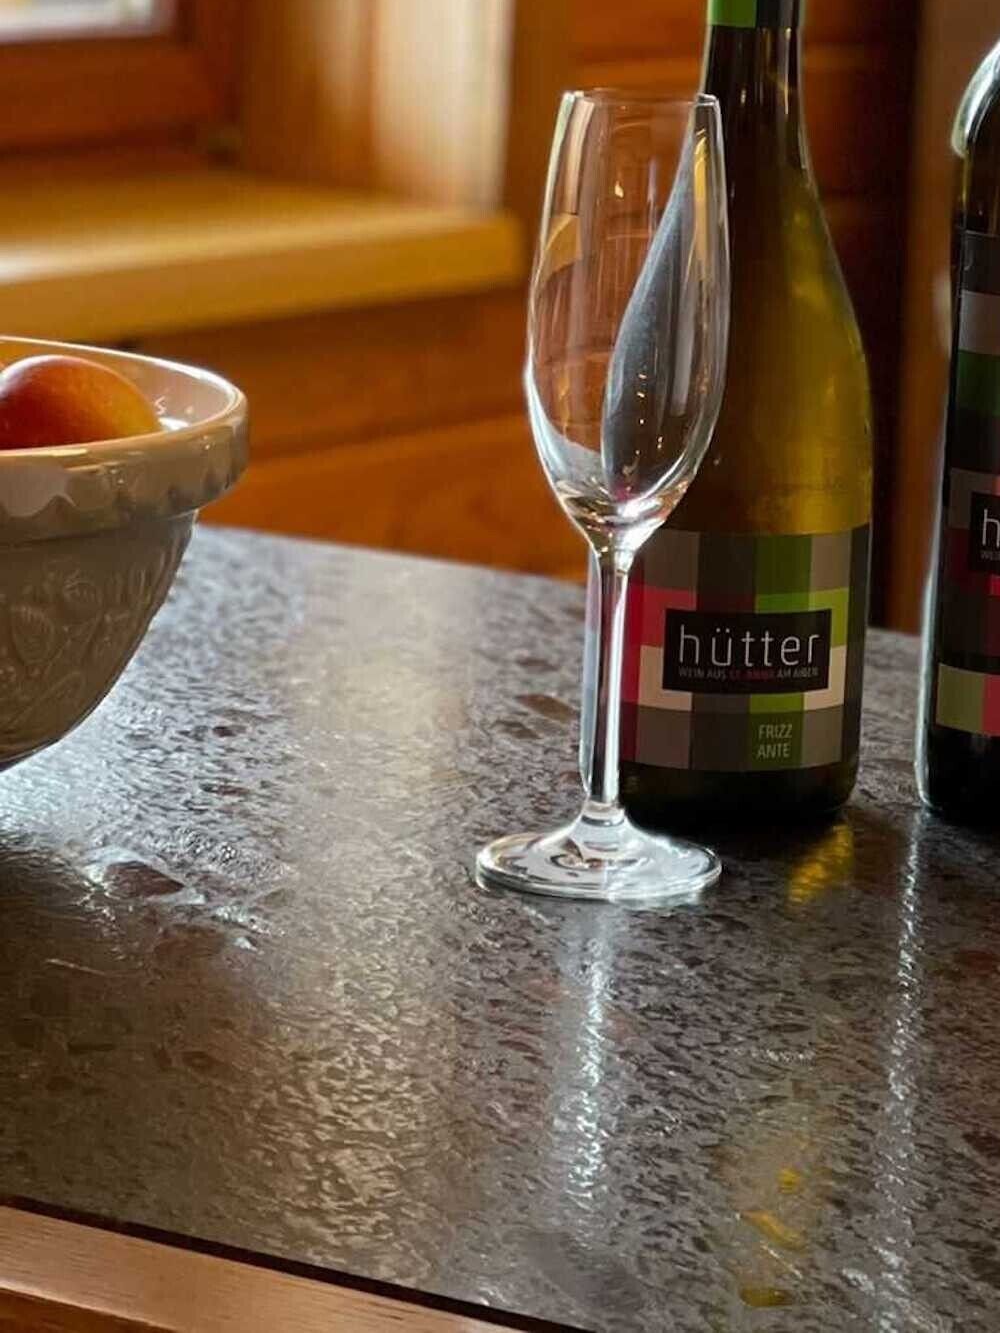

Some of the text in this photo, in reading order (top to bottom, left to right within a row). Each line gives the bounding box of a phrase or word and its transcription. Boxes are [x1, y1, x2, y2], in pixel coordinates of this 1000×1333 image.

[679, 624, 820, 666] hütter
[759, 723, 793, 739] FRIZZ
[757, 743, 790, 759] ANTE
